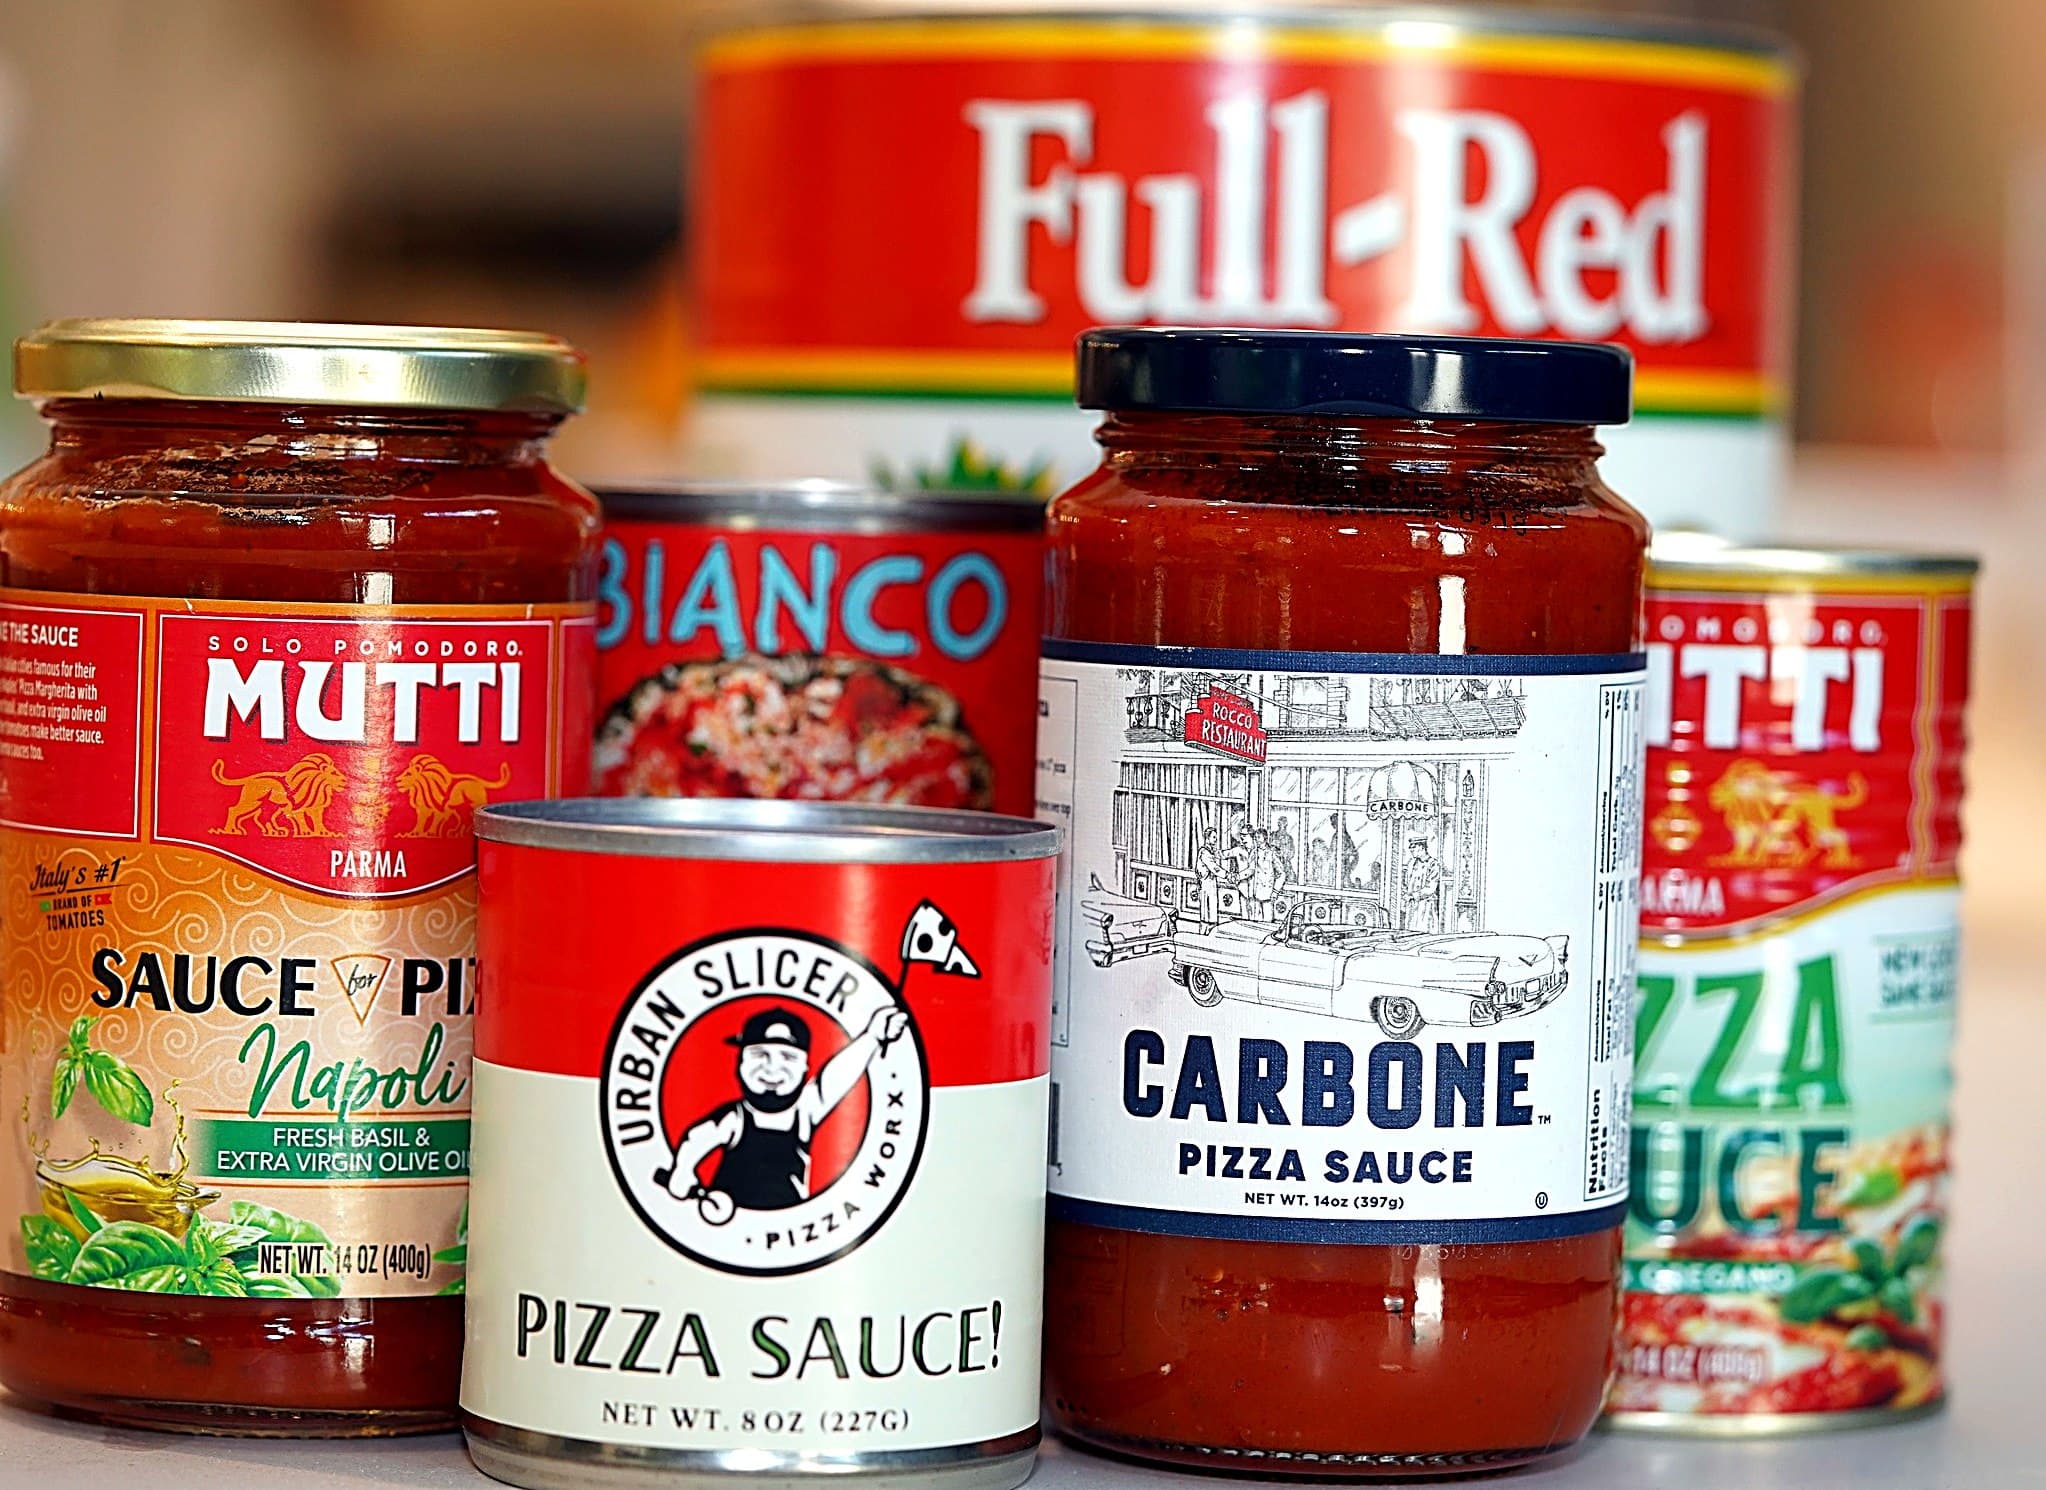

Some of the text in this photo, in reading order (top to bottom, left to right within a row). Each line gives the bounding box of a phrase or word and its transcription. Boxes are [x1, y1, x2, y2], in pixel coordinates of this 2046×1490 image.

[962, 87, 1710, 343] Full-Red
[596, 537, 1008, 660] BIANCO
[10, 622, 29, 644] THE
[31, 625, 79, 648] SAUCE
[208, 635, 302, 655] SOLO
[33, 659, 60, 677] famous
[61, 661, 73, 679] for
[74, 662, 96, 680] their
[35, 680, 76, 700] Margherita
[77, 684, 98, 701] with
[203, 658, 521, 743] MUTTI
[1646, 642, 1883, 752] TTI
[48, 703, 70, 722] virgin
[71, 705, 93, 721] olive
[94, 706, 107, 723] oil
[1213, 702, 1252, 729] ROCCO
[50, 724, 74, 742] better
[75, 728, 104, 745] sauce.
[1202, 719, 1267, 757] RESTAURANT
[1369, 800, 1430, 815] CARBONE
[30, 861, 87, 894] Italy's
[330, 850, 407, 879] PARMA
[46, 909, 105, 931] TOMATOES
[53, 894, 92, 911] BRAND OF
[91, 948, 316, 1017] SAUCE
[347, 964, 376, 996] for
[693, 948, 860, 1013] SLICER
[239, 1023, 467, 1123] Napoli
[617, 990, 686, 1147] URBAN
[1123, 1029, 1535, 1130] CARBONE
[273, 1127, 431, 1148] FRESH BASIL &
[864, 1090, 905, 1190] WORX
[1588, 1089, 1601, 1194] Nutrition
[217, 1151, 288, 1171] EXTRA
[296, 1152, 372, 1173] VIRGIN
[380, 1151, 440, 1171] OLIVE
[1179, 1143, 1473, 1184] PIZZA SAUCE
[1598, 1127, 1608, 1192] Facts
[1629, 1126, 1851, 1236] UCE
[1245, 1191, 1404, 1212] NET WT. 14oz (397g)
[765, 1200, 861, 1250] PIZZA
[260, 1244, 431, 1279] NET WT. 14 OZ (400g)
[517, 1293, 1002, 1380] PIZZA SAUCE!
[601, 1402, 657, 1427] NET
[670, 1408, 730, 1432] WT.
[820, 1411, 909, 1433] (227G)
